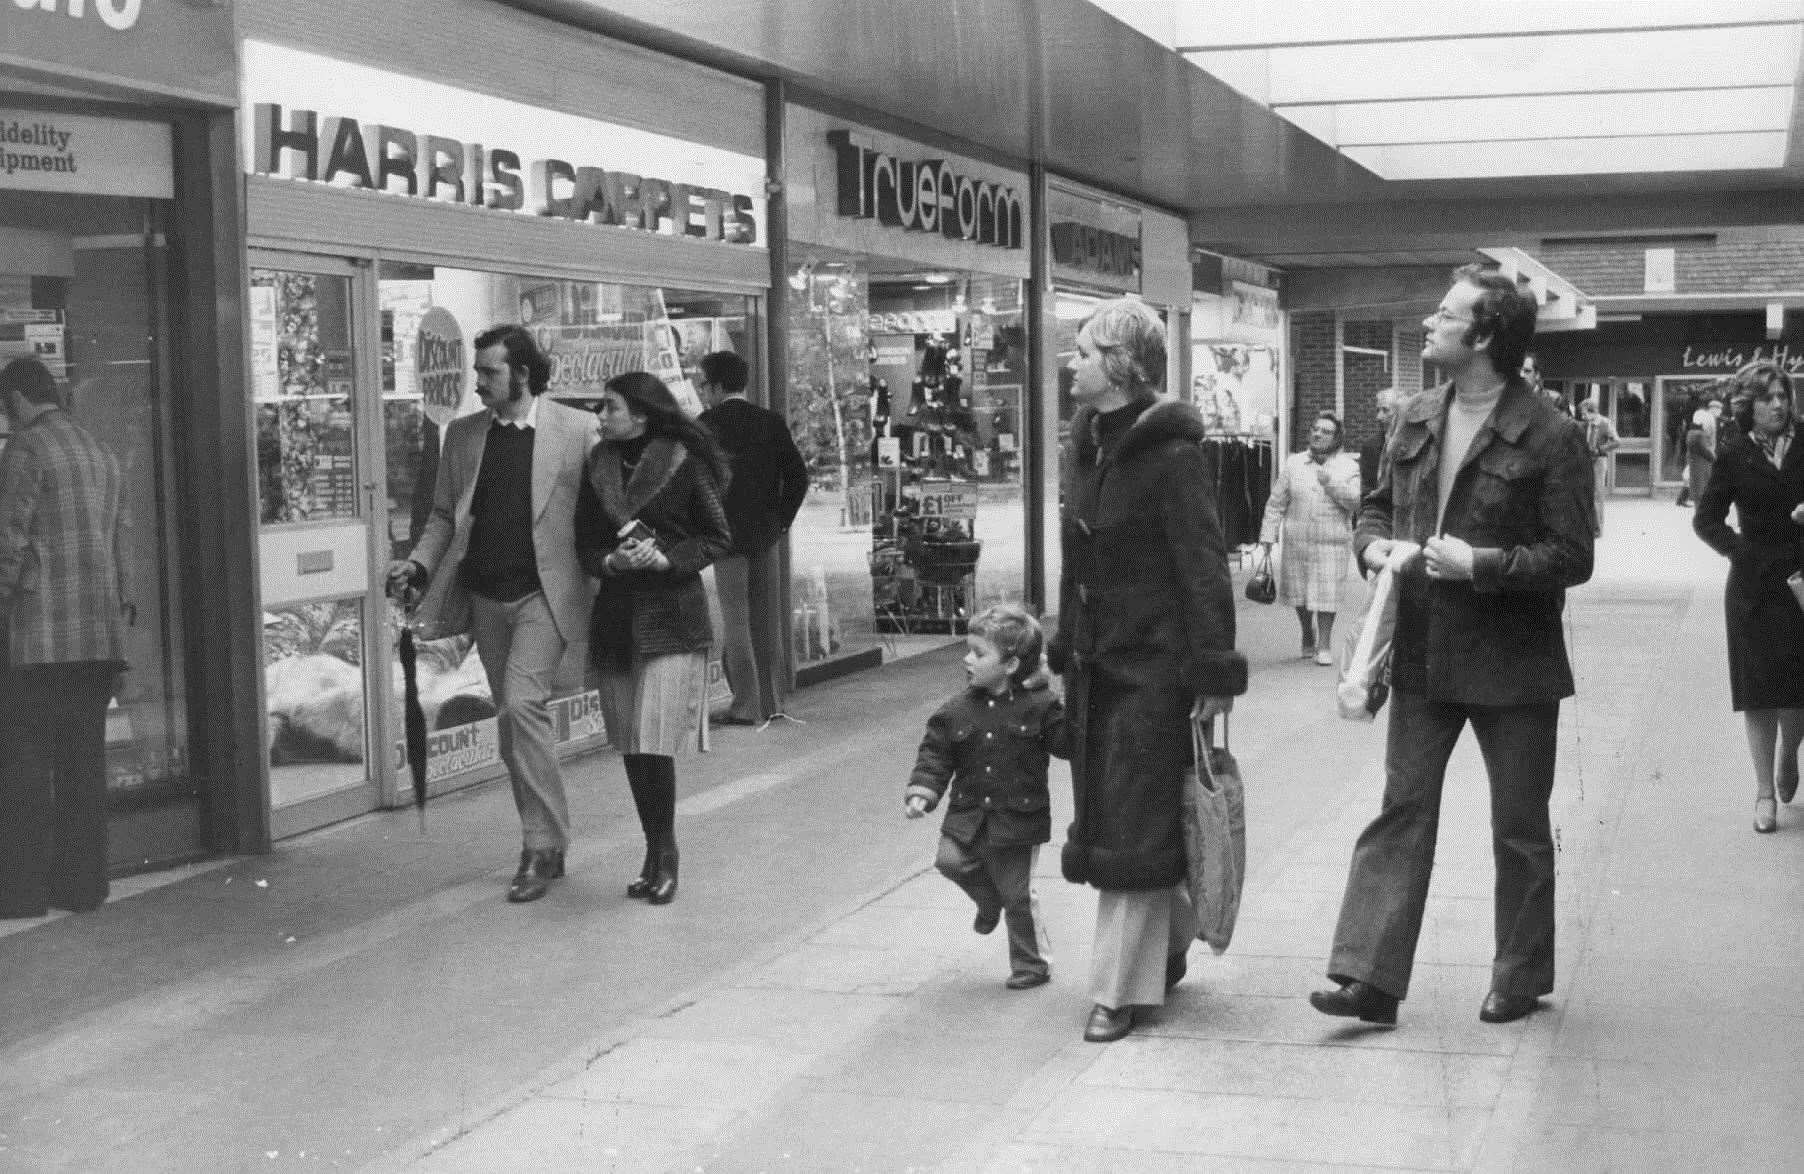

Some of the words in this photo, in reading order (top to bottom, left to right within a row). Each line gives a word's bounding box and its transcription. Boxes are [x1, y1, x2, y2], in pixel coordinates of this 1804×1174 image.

[253, 102, 525, 210] HARRIS
[530, 158, 757, 244] CARPETS
[826, 129, 1025, 249] Trueform
[1682, 345, 1744, 368] Lewis
[922, 494, 944, 515] £1
